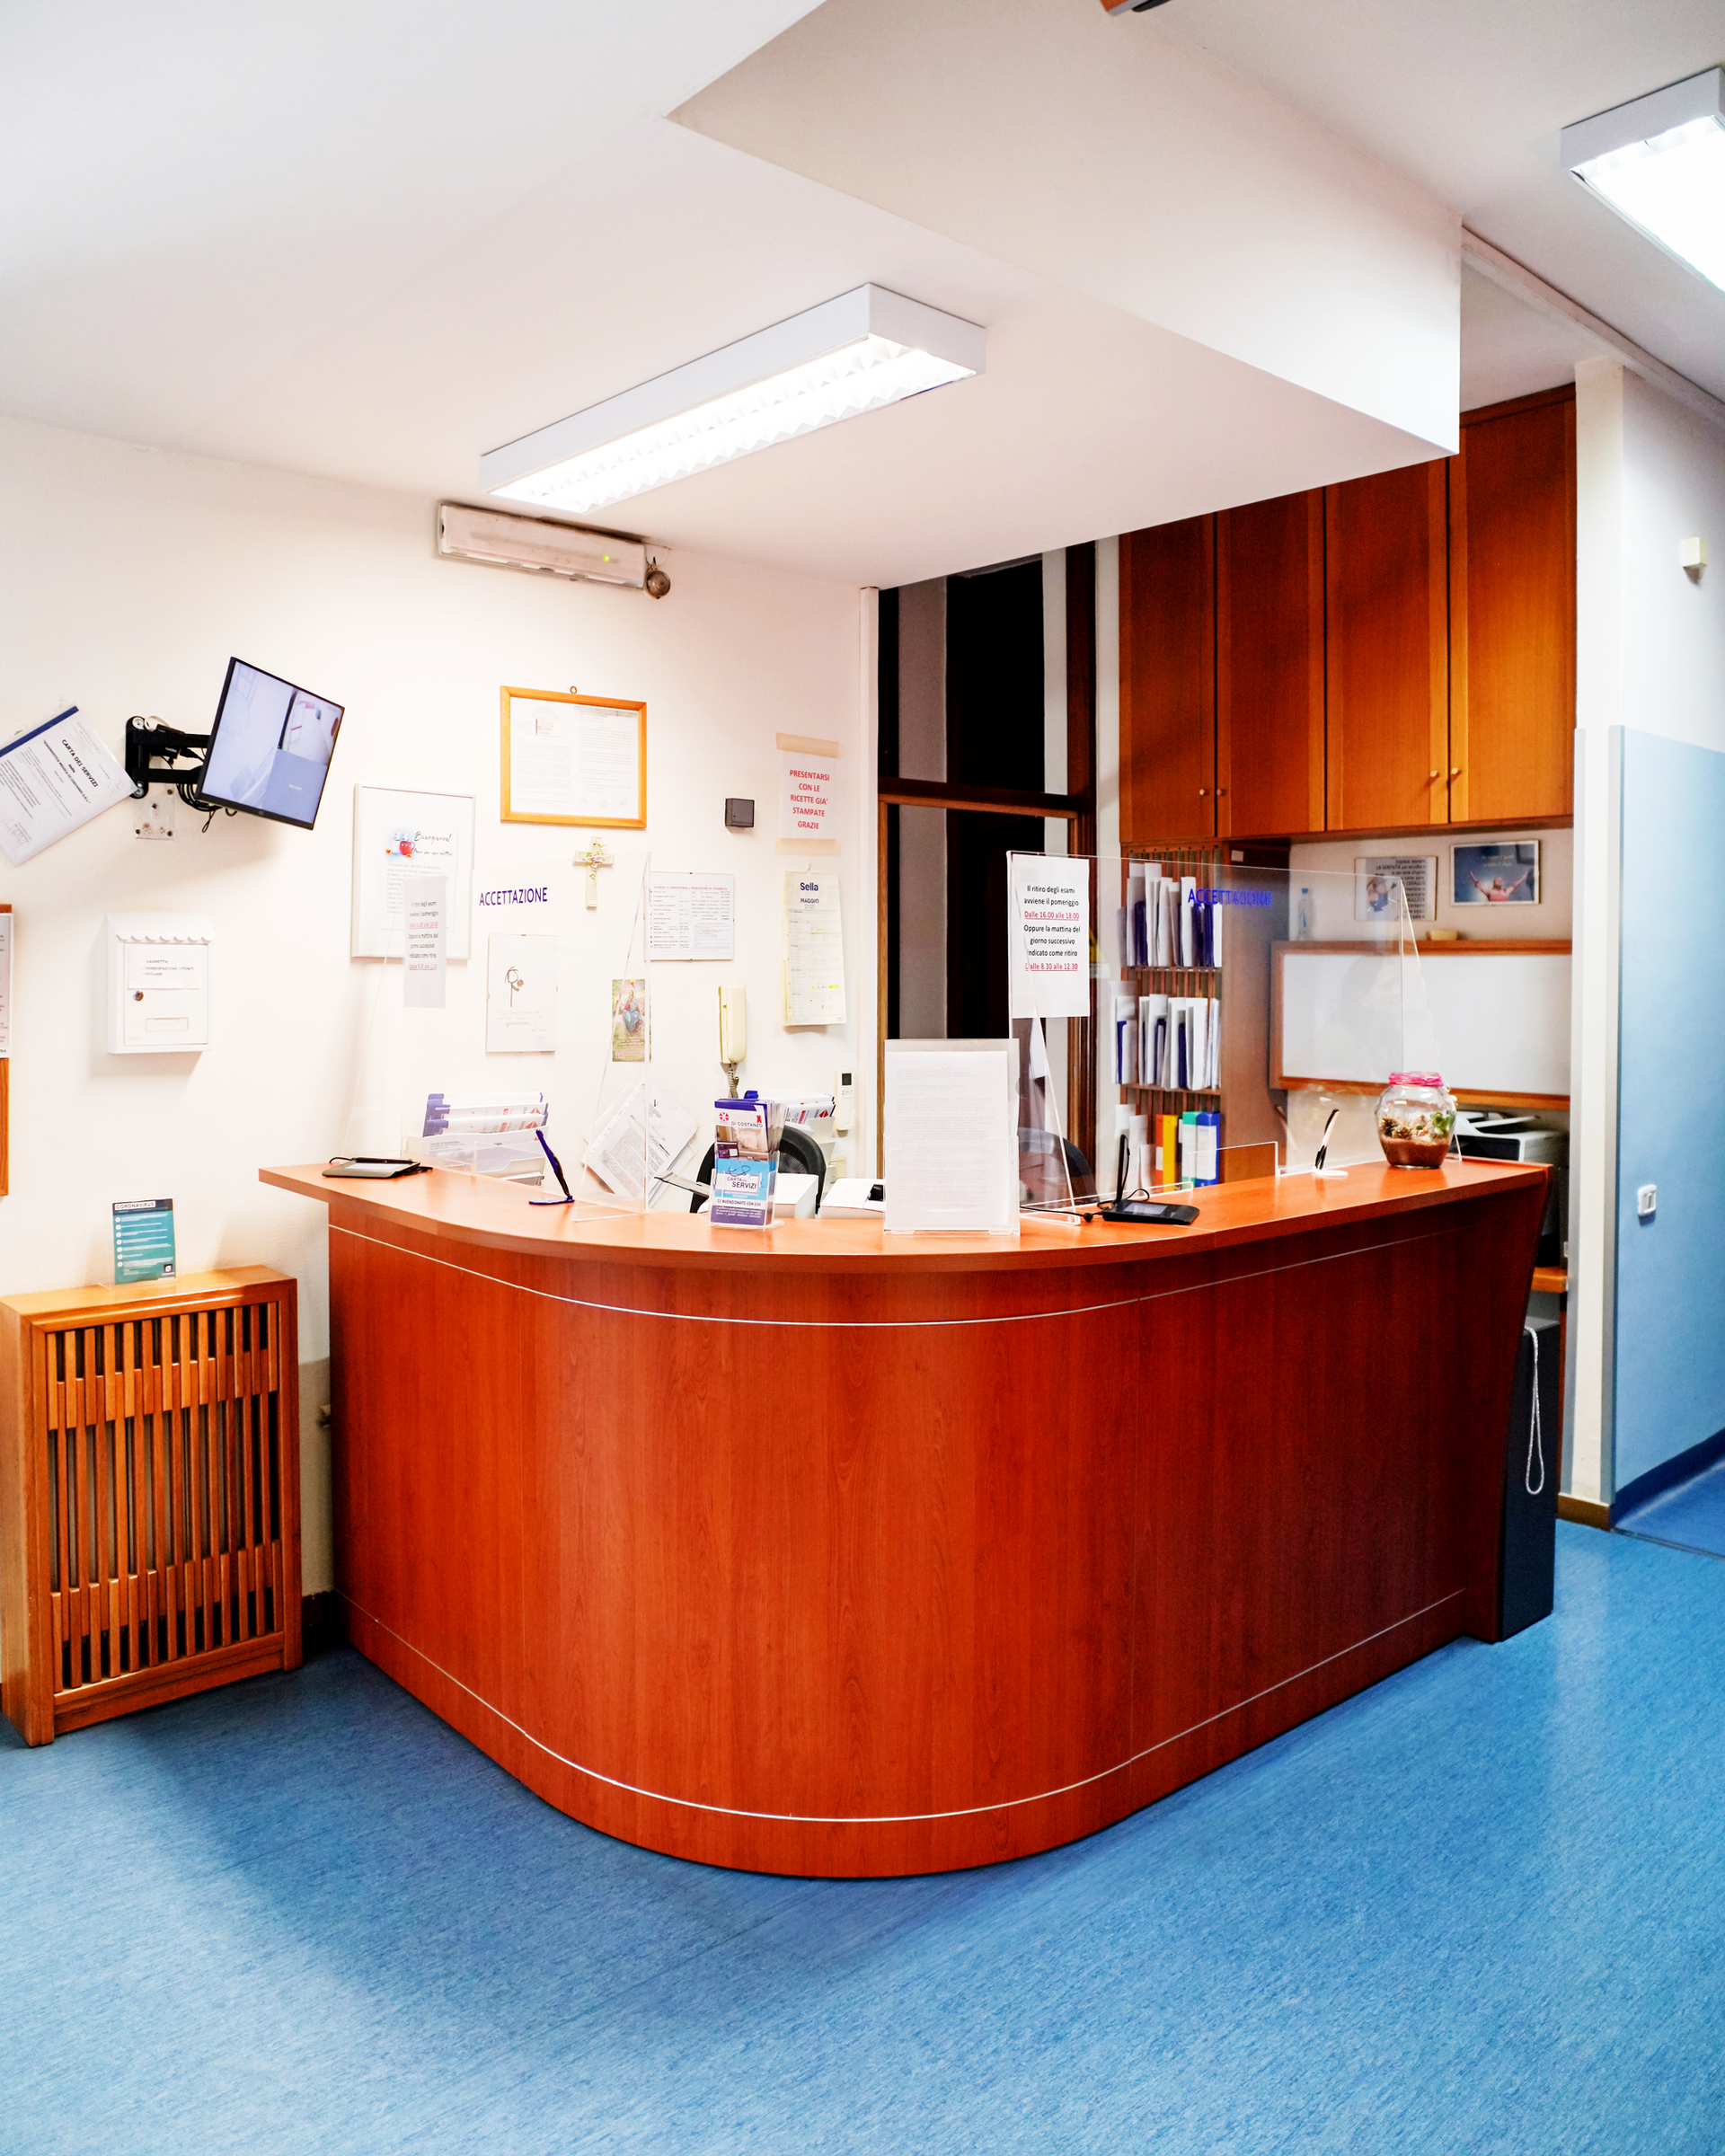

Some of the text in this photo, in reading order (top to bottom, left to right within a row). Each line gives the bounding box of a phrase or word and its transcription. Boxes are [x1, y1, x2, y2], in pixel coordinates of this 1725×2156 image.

[61, 739, 75, 756] CARTA
[74, 756, 83, 767] DEI
[81, 766, 99, 788] SERVIZI
[790, 769, 830, 782] PRESENTARSI
[799, 783, 812, 791] CON
[791, 794, 814, 804] RICETTE
[792, 807, 826, 817] STAMPATE
[798, 821, 819, 830] GRAZIE
[800, 882, 818, 891] Sella
[1047, 886, 1060, 895] degli
[479, 888, 548, 906] ACCETTAZIONE
[1188, 888, 1274, 907] ACCETTAZIONE
[1051, 898, 1079, 907] pomeriggio
[1039, 911, 1055, 919] 16.00
[1024, 924, 1045, 932] Oppure
[1030, 937, 1048, 945] giorno
